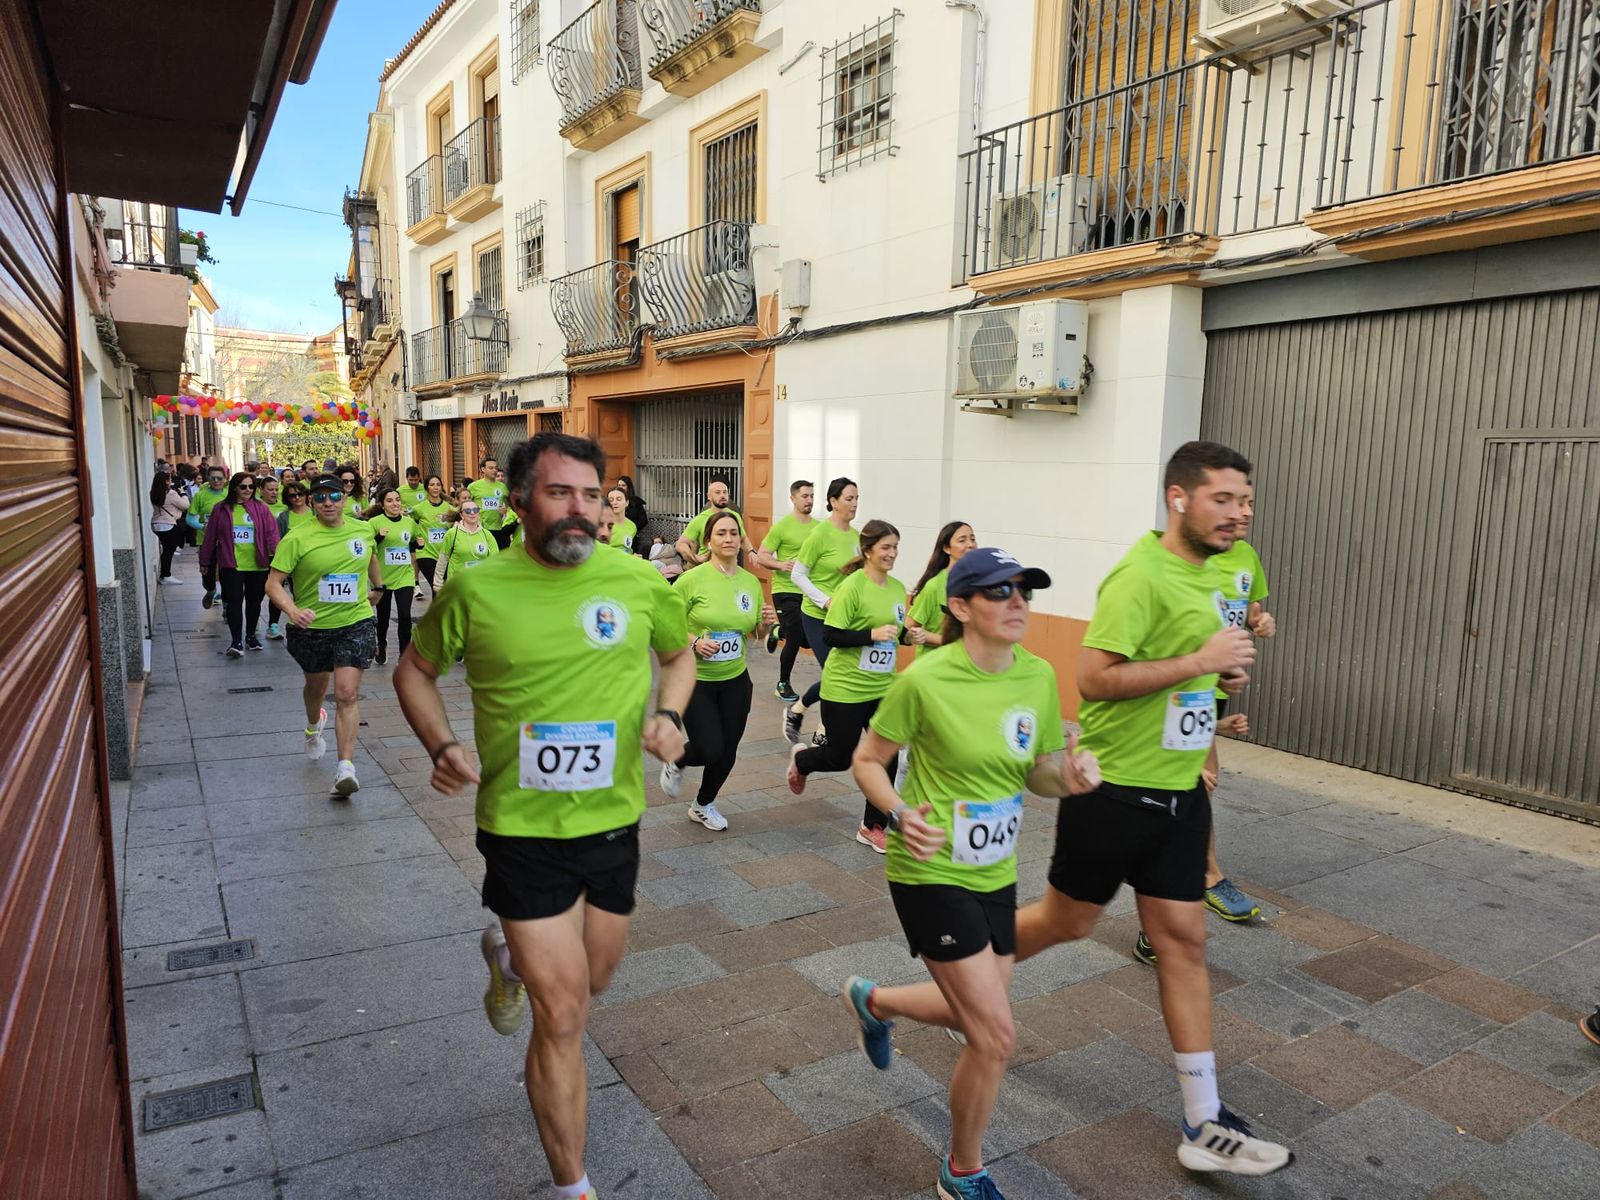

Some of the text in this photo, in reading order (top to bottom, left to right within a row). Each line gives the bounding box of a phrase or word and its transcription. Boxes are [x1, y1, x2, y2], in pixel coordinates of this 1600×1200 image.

[777, 384, 787, 400] 14
[482, 393, 498, 414] Nice
[499, 389, 519, 412] Hair
[389, 552, 407, 561] 145
[328, 583, 351, 595] 114
[1227, 610, 1244, 627] 98
[714, 639, 739, 654] 06
[869, 650, 893, 665] 027
[537, 745, 601, 774] 073
[969, 815, 1017, 850] 049
